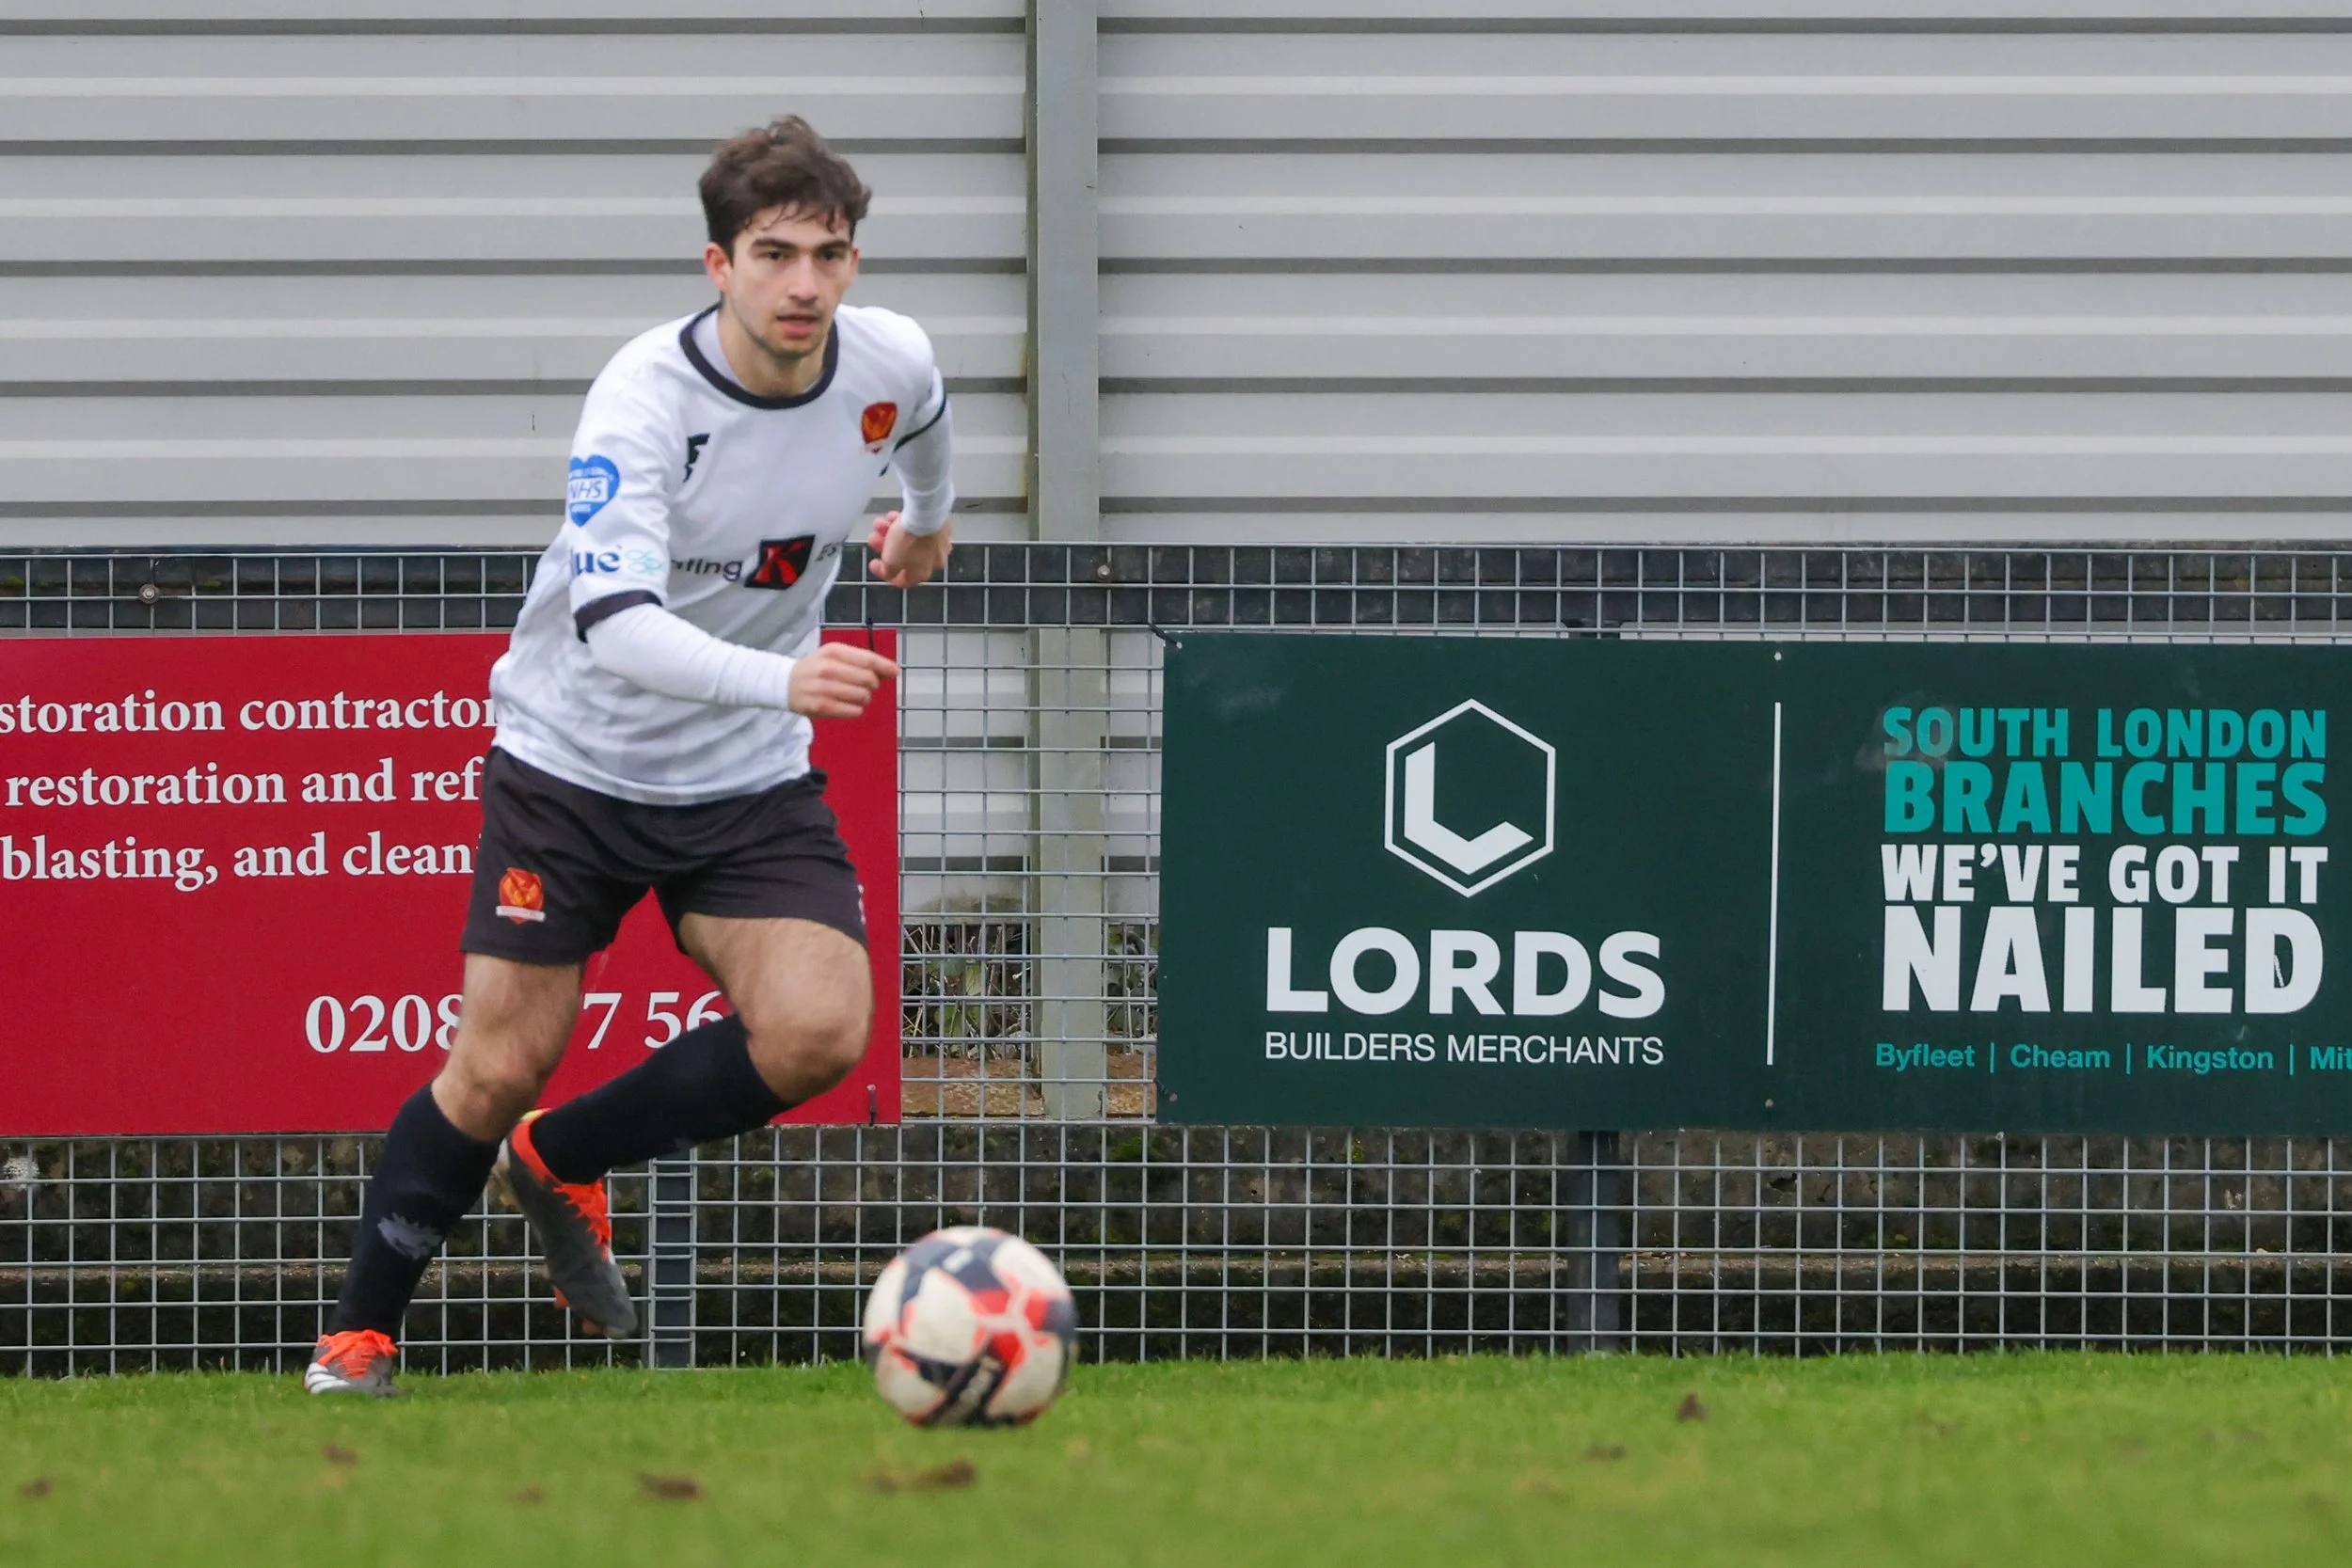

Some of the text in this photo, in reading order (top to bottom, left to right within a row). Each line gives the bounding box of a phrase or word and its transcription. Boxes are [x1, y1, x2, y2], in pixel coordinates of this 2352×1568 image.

[569, 479, 603, 500] NHS
[570, 548, 621, 576] ue
[753, 540, 807, 585] K
[0, 689, 226, 734] storation
[1883, 706, 2327, 759] SOUTH LONDON
[5, 761, 288, 807] restoration
[301, 756, 397, 803] and
[1883, 761, 2328, 835] BRANCHES
[0, 830, 482, 893] blasting, and clean
[2108, 845, 2240, 904] GOT
[2268, 846, 2328, 904] IT
[1266, 927, 1665, 1019] LORDS
[1883, 906, 2324, 1014] NAILED
[305, 993, 464, 1053] 0208
[1265, 1031, 1664, 1065] BUILDERS MERCHANTS
[1875, 1042, 2352, 1075] Byfleet Cheam Kingston Mit
